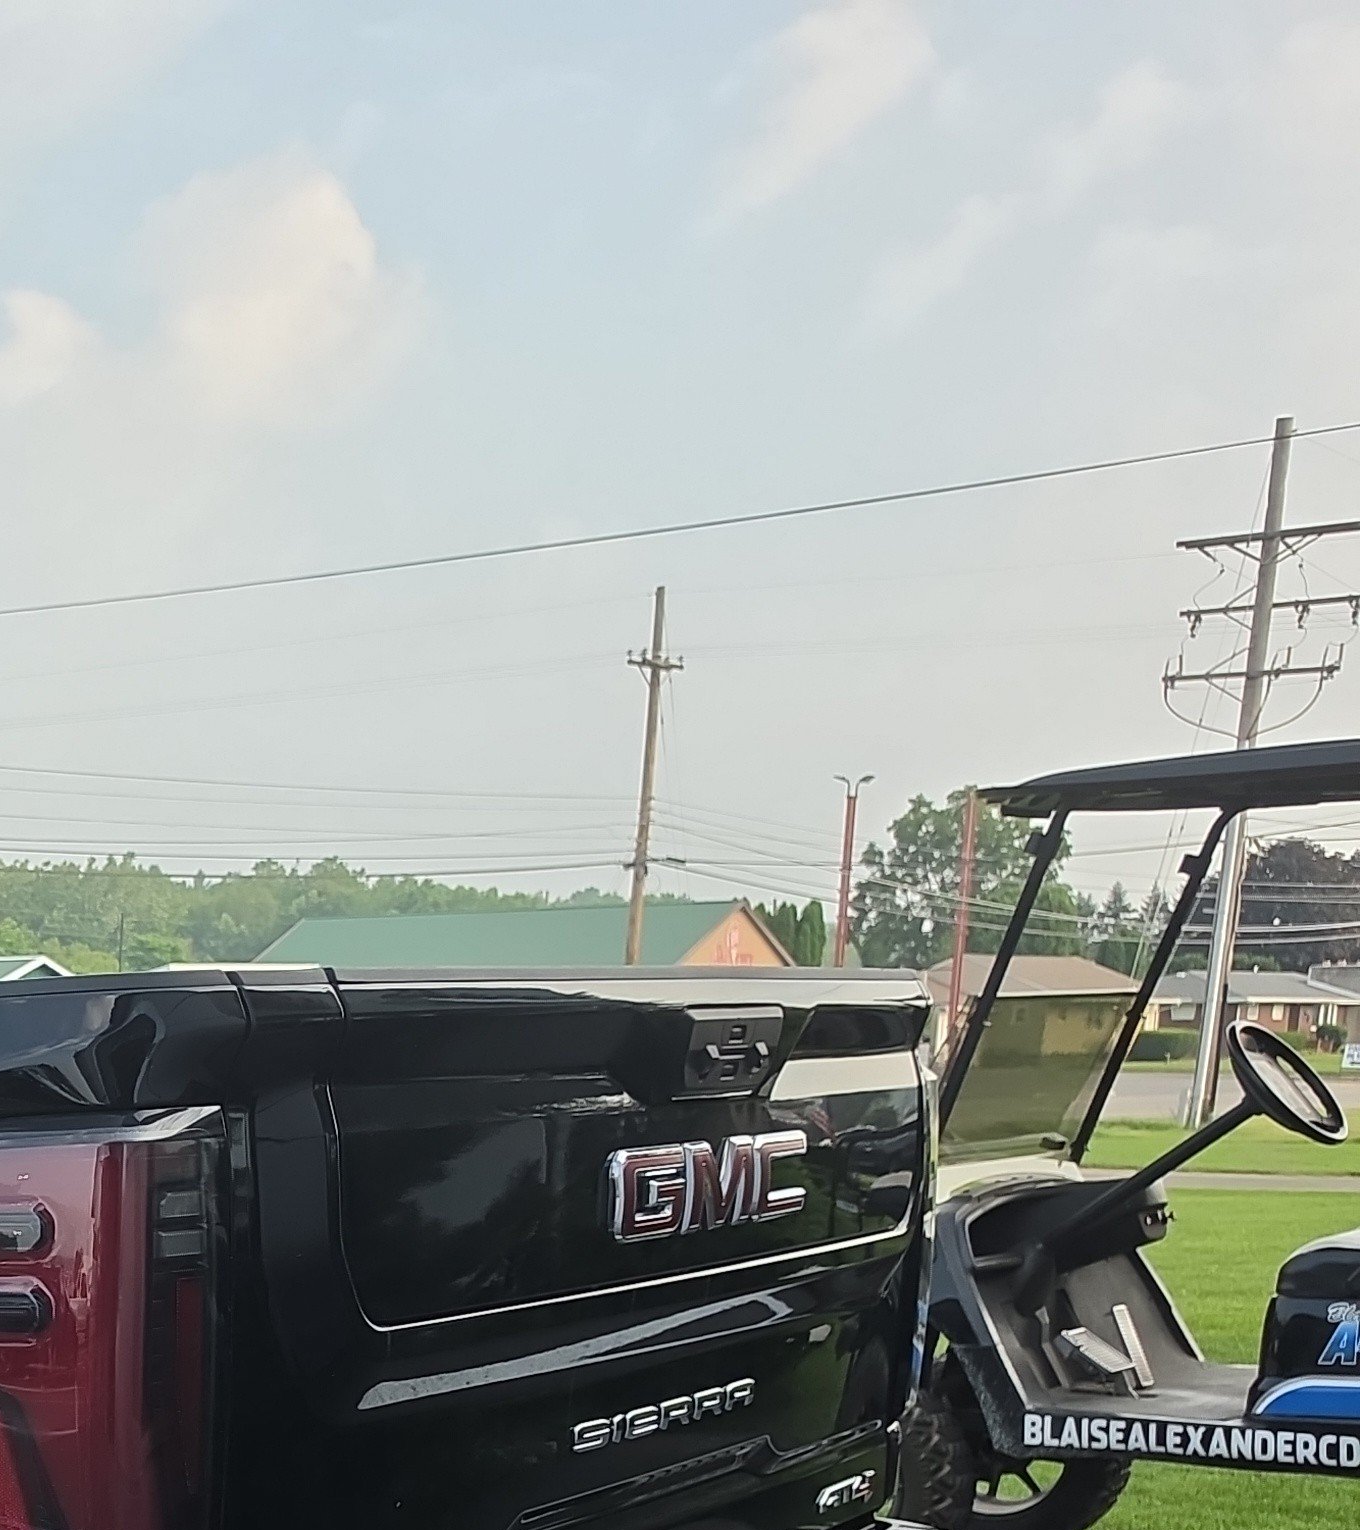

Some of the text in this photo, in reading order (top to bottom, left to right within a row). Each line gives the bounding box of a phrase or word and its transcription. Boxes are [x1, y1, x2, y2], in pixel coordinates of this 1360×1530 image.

[606, 1129, 808, 1242] GMC
[571, 1377, 756, 1454] SIERRA
[816, 1469, 876, 1515] AT4
